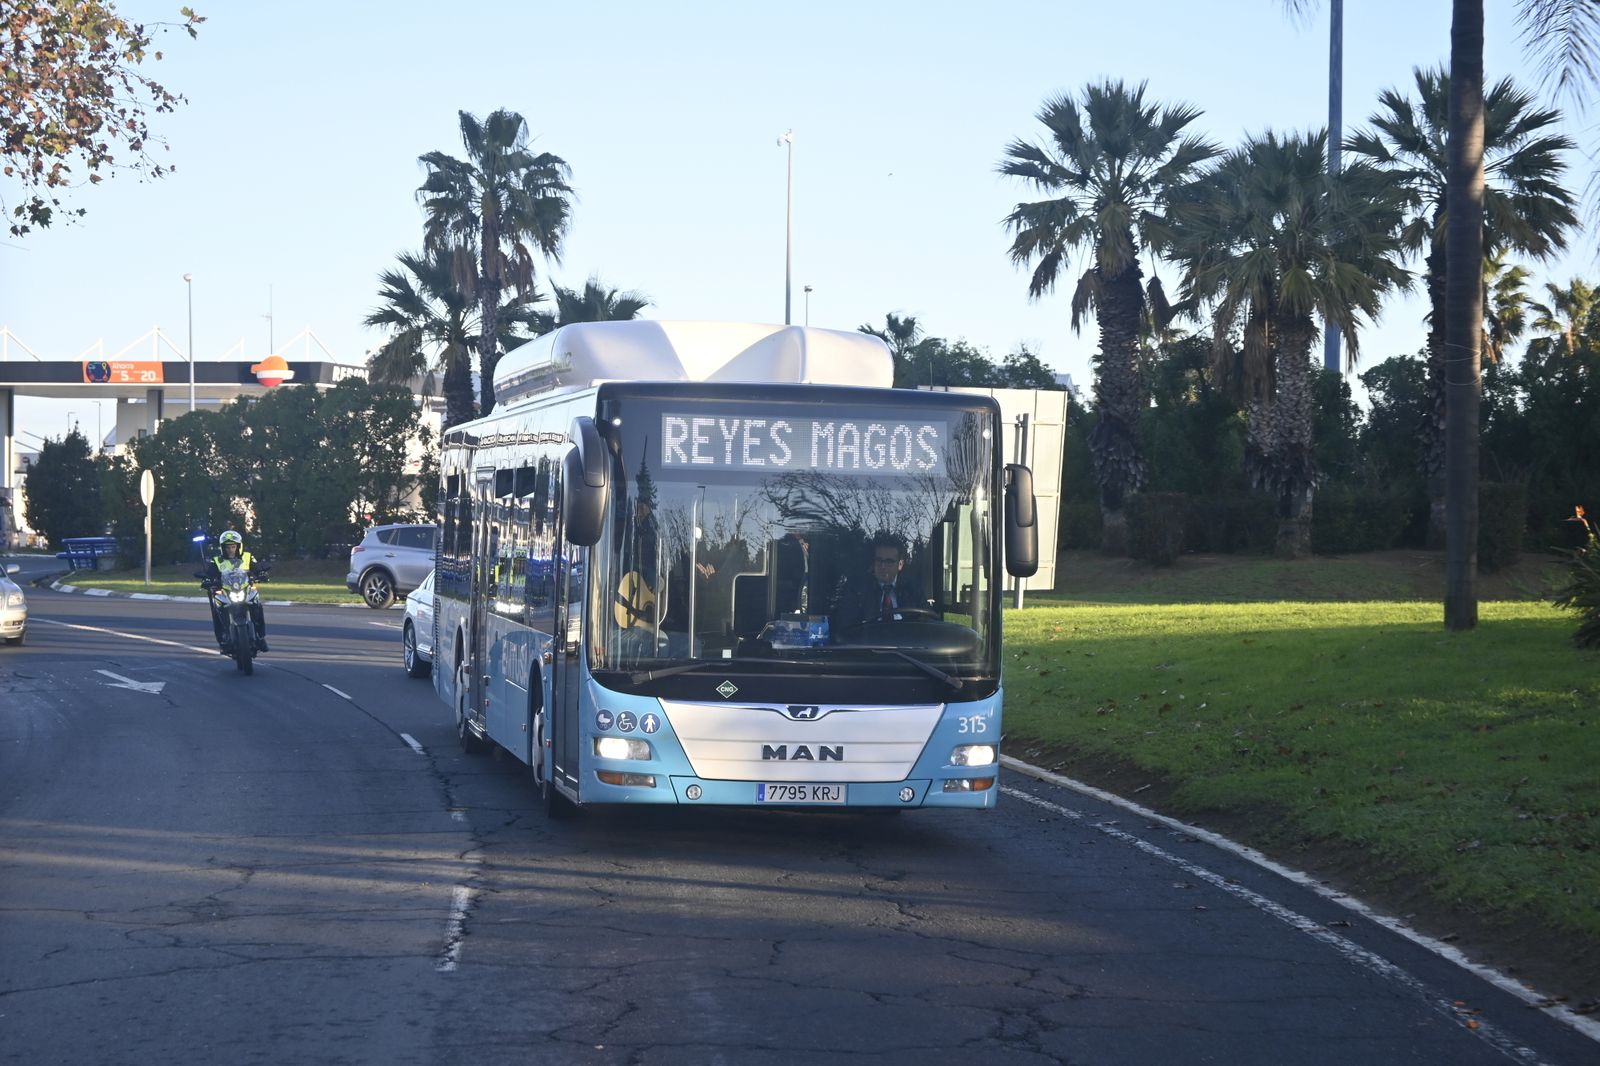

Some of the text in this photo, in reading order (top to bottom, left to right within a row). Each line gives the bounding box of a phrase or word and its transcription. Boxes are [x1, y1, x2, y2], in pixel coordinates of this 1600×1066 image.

[121, 370, 155, 381] 5 20
[664, 416, 939, 470] REYES MAGOS
[958, 716, 987, 734] 315
[762, 744, 844, 761] MAN
[769, 785, 807, 800] 7795
[812, 786, 840, 801] KRJ
